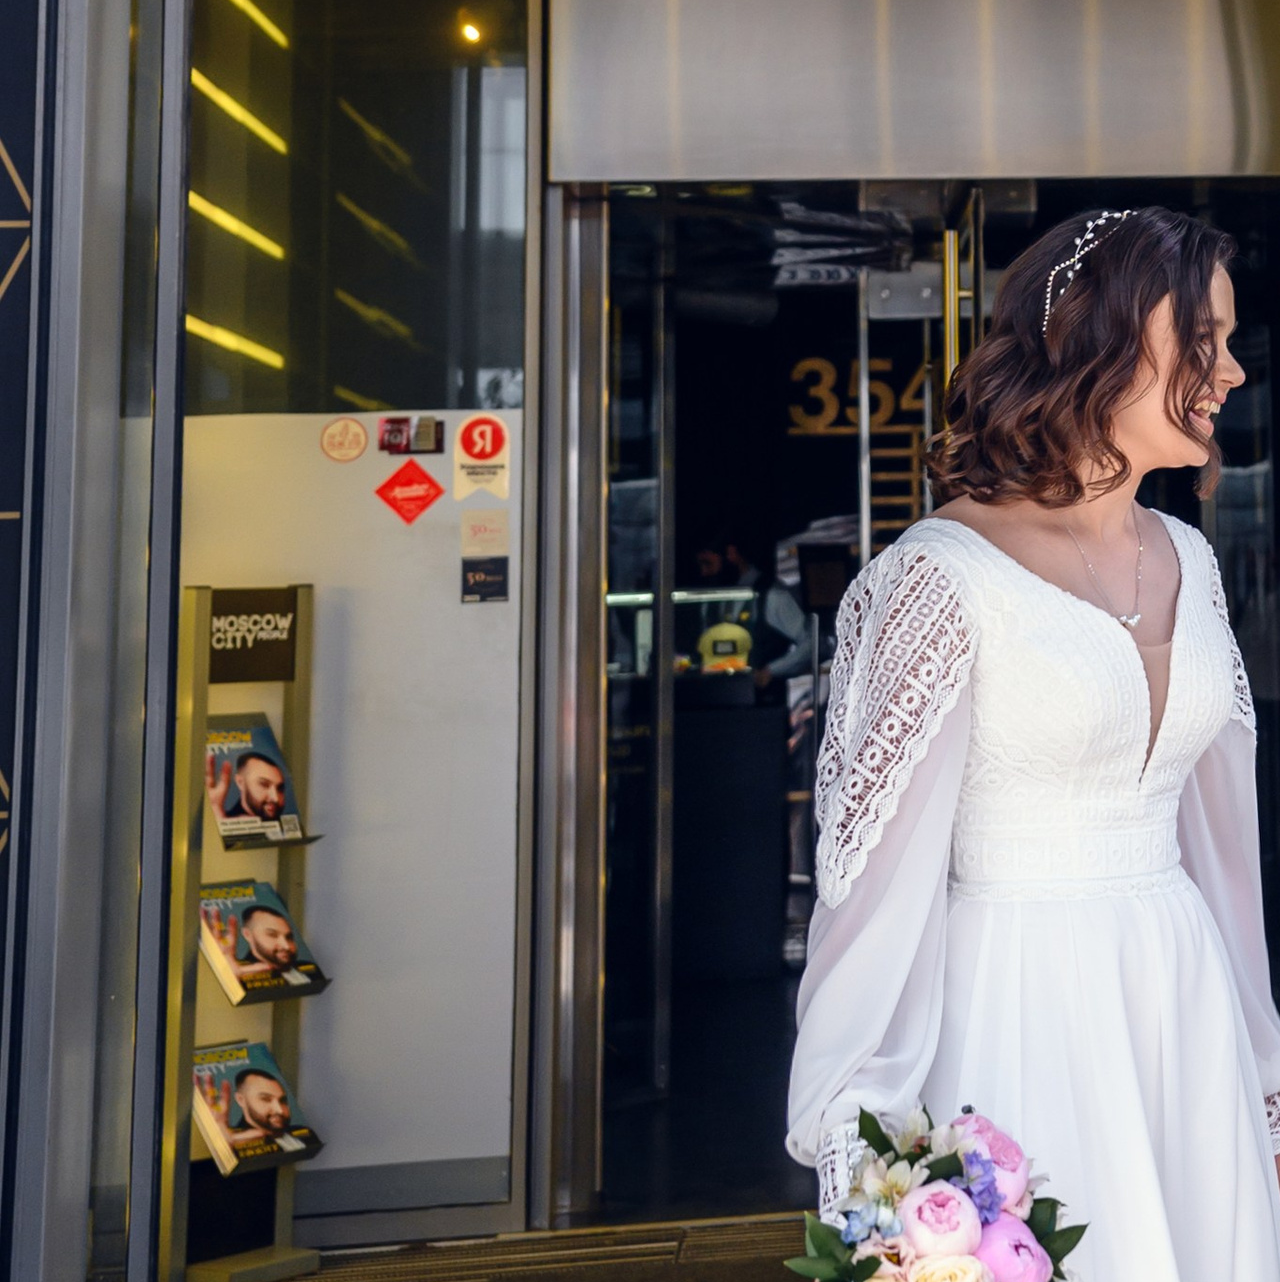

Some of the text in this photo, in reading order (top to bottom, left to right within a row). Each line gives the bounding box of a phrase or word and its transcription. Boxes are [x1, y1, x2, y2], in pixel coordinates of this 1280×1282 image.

[473, 424, 493, 454] Я
[211, 612, 294, 633] MOSCOW
[211, 630, 257, 650] CITY
